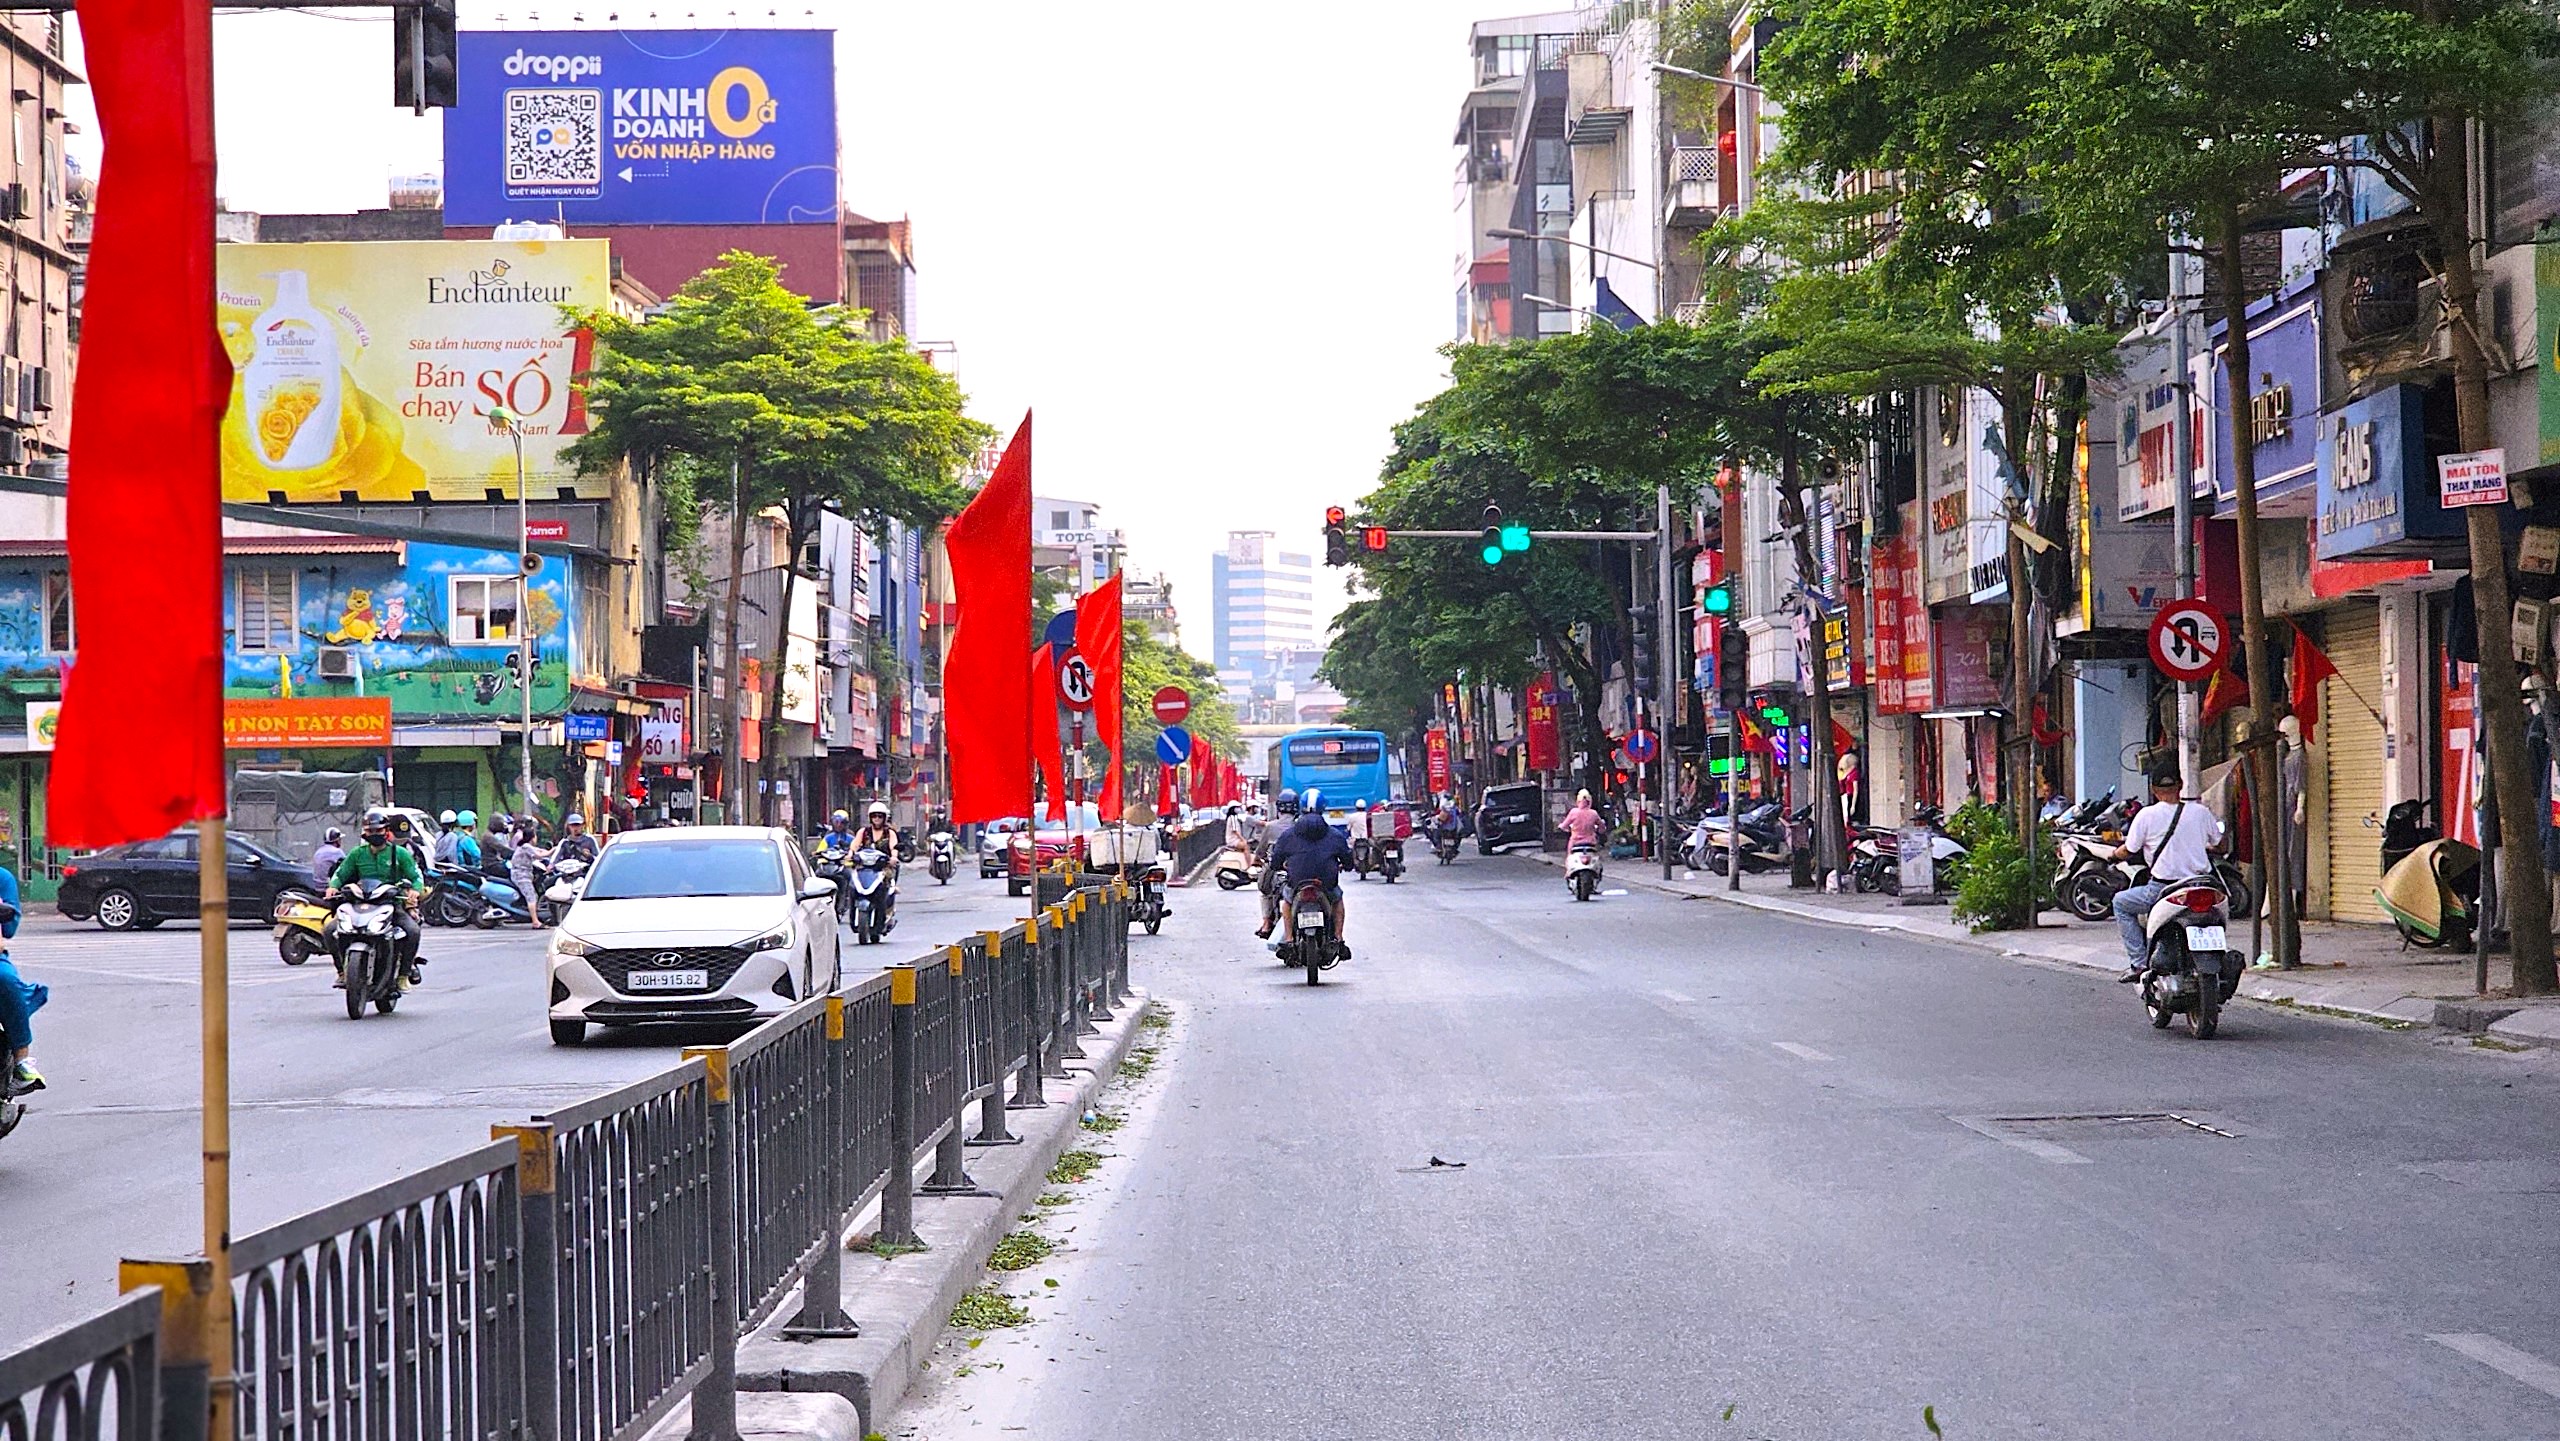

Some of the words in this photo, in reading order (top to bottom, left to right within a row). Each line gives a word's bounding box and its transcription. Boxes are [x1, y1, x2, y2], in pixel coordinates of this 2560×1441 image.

[503, 48, 602, 83] droppii
[613, 88, 705, 117] KINH
[613, 118, 705, 139] DOANH
[614, 138, 657, 159] VỐN
[661, 140, 716, 164] NHẬP
[719, 140, 776, 160] HÀNG
[552, 187, 573, 196] NGAY
[219, 292, 262, 307] Protein
[428, 270, 572, 304] Enchanteur
[408, 338, 432, 351] Sữa
[461, 338, 501, 353] hương
[505, 338, 536, 350] nước
[540, 337, 563, 349] hoa
[415, 361, 465, 388] Bán
[402, 393, 464, 425] chạy
[1366, 526, 1387, 550] 10
